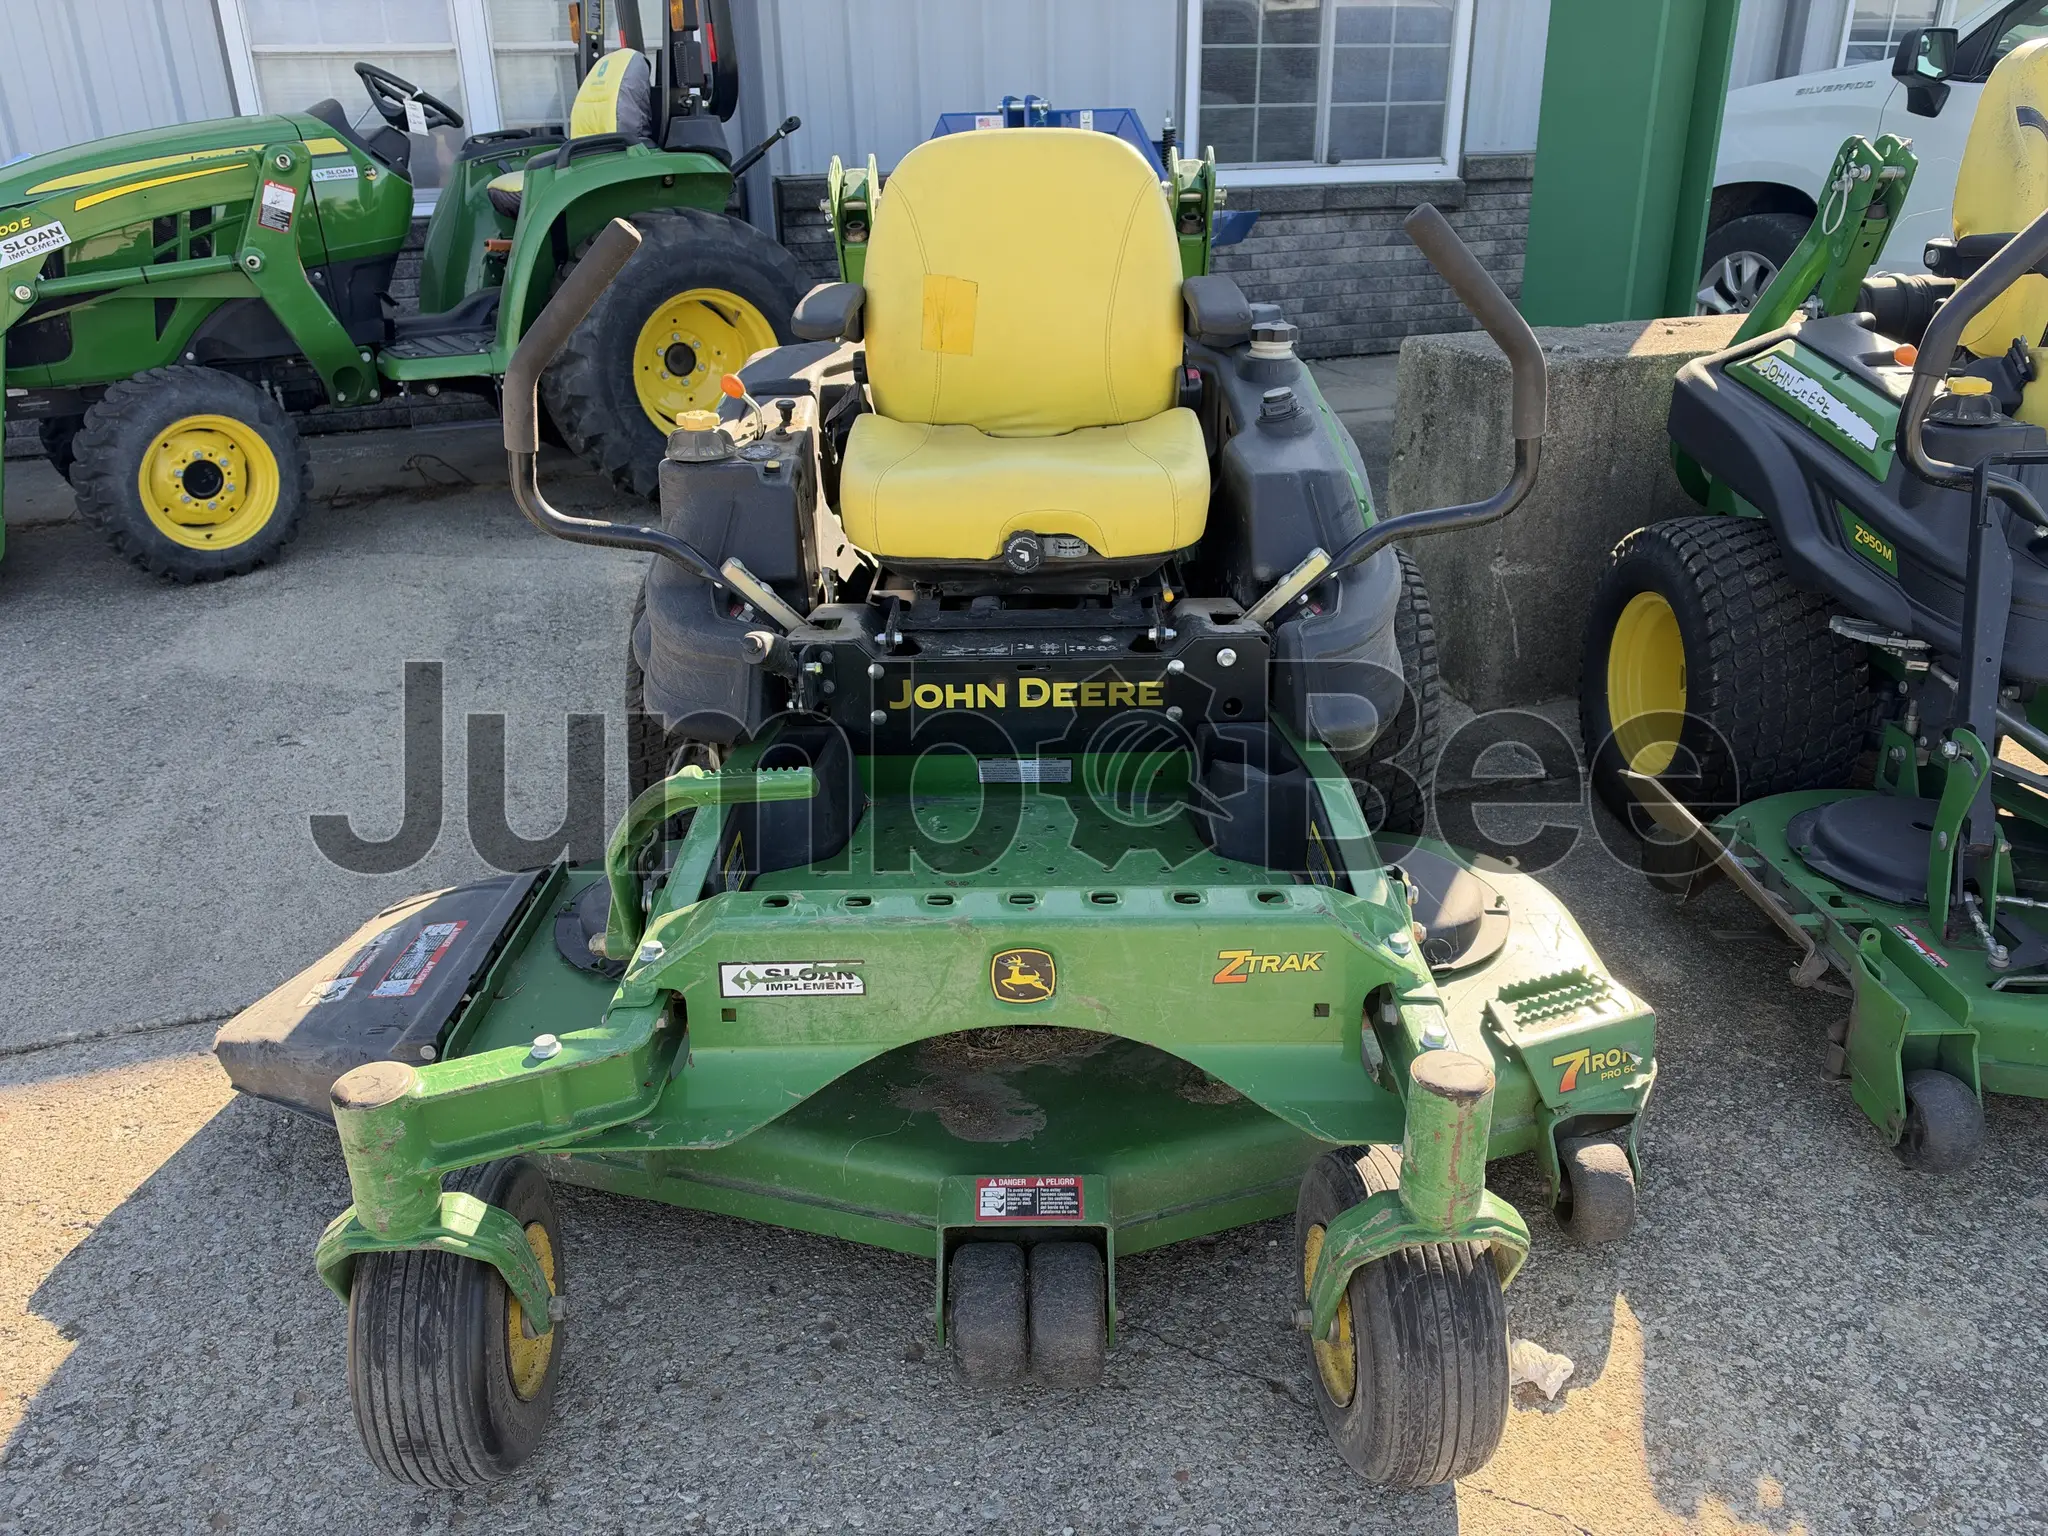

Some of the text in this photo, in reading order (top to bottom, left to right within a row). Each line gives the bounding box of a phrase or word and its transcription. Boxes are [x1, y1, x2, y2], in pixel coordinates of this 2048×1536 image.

[1795, 80, 1876, 96] SILVERADO
[3, 226, 62, 253] SLOAN
[8, 236, 65, 260] IMPLEMENT
[1761, 359, 1795, 386] JOHN
[1855, 524, 1892, 562] Z950M
[889, 677, 1164, 709] JOHN DEERE
[765, 982, 855, 991] IMPLEMENT
[1601, 1068, 1621, 1081] PRO
[1045, 1178, 1075, 1186] PELIGRO
